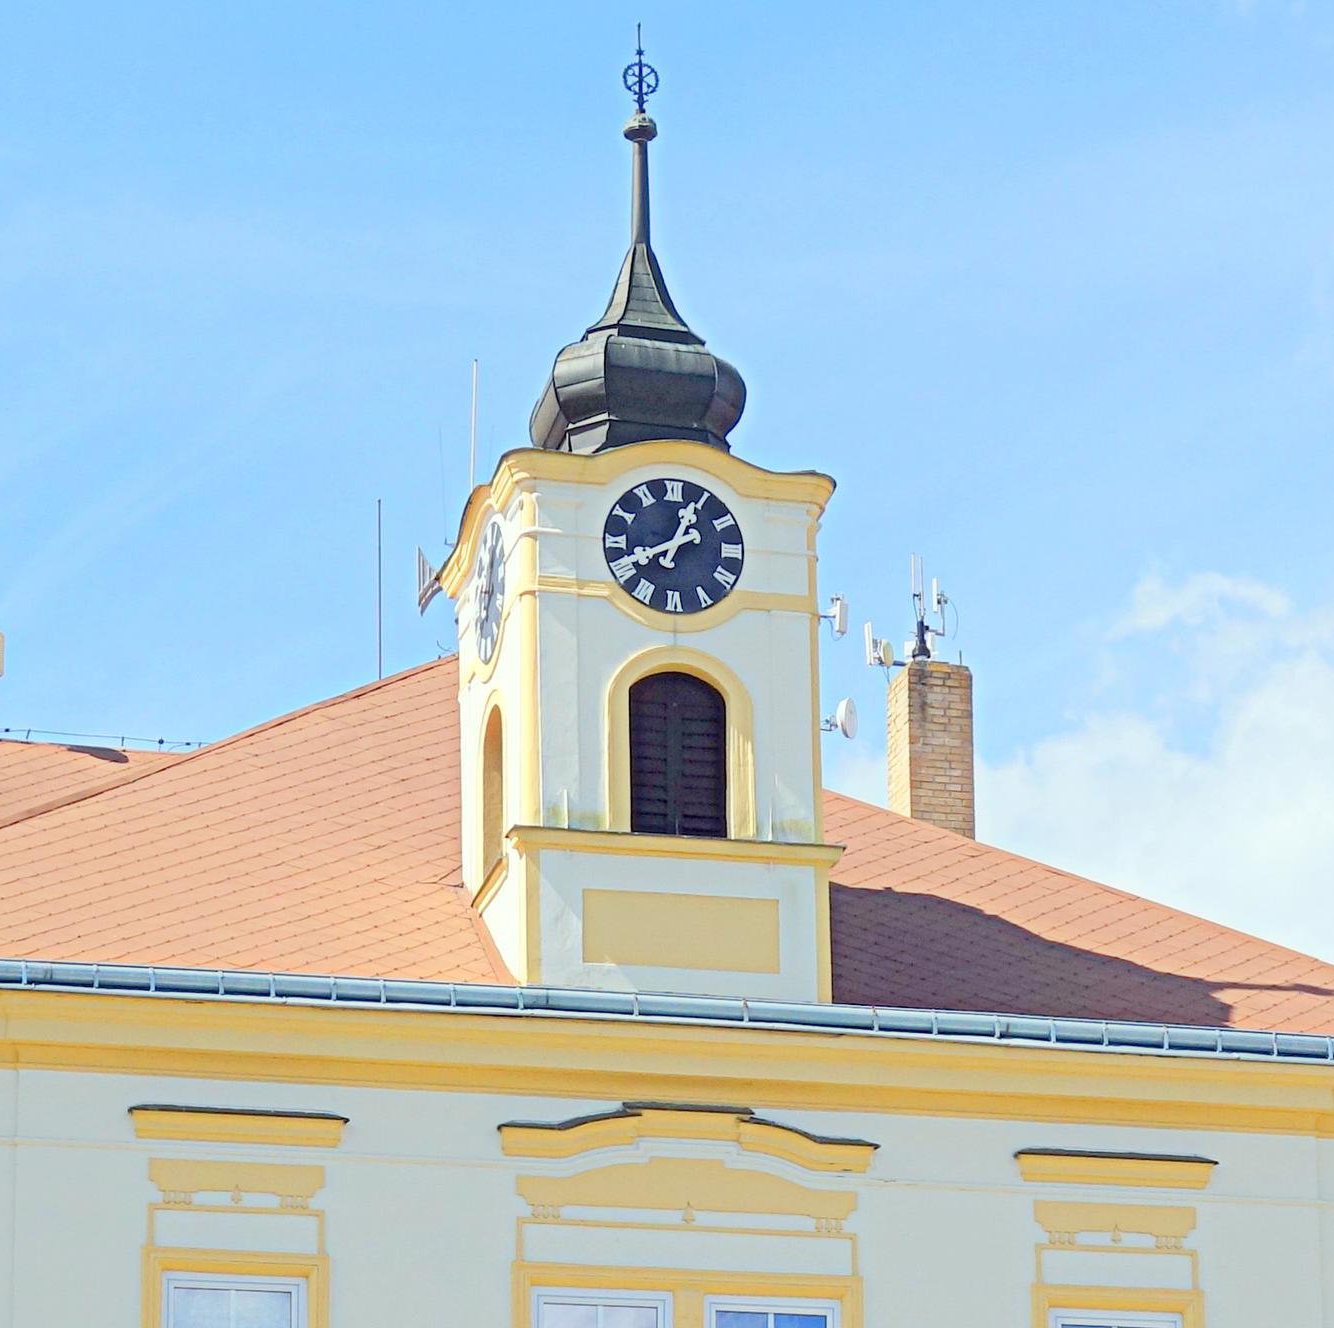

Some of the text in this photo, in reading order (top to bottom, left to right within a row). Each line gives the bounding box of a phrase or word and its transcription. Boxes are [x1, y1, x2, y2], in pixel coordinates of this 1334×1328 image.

[633, 484, 656, 507] XI
[664, 480, 683, 502] XII
[694, 491, 711, 510] I
[612, 504, 636, 525] X
[712, 513, 735, 532] II
[605, 533, 627, 550] IX
[721, 542, 742, 560] III
[632, 578, 655, 605] VII
[666, 590, 683, 612] VI
[696, 586, 714, 608] V
